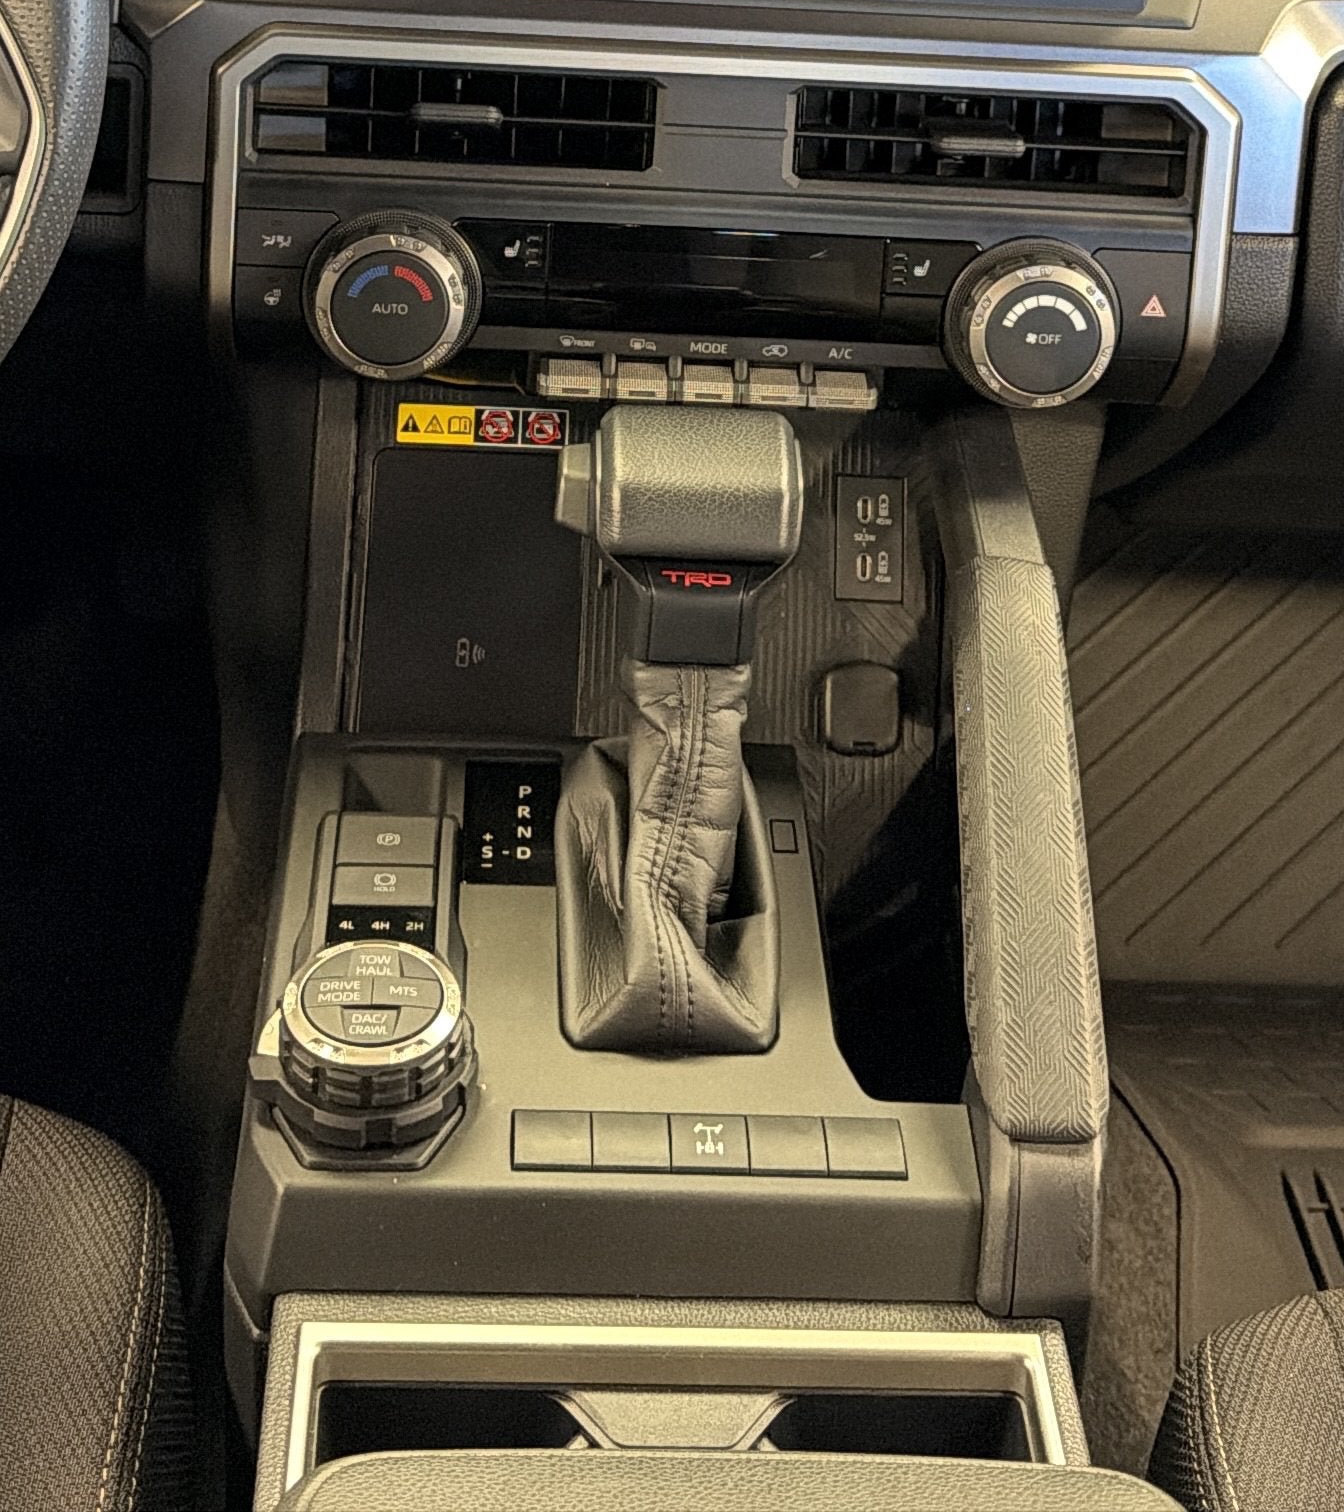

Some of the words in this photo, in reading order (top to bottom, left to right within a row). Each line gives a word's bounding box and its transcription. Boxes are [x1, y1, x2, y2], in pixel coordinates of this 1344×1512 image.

[371, 303, 409, 316] AUTO
[1037, 333, 1063, 345] OFF
[689, 341, 729, 355] MODE
[828, 347, 855, 360] A/C
[661, 570, 733, 588] TRD
[518, 786, 532, 799] P
[517, 805, 532, 819] R
[517, 826, 533, 839] N
[481, 845, 494, 859] S
[516, 846, 532, 860] D
[338, 920, 355, 931] 4L
[370, 920, 390, 931] 4H
[405, 921, 424, 931] 2H
[359, 954, 392, 965] TOW
[356, 966, 393, 977] HAUL
[319, 980, 362, 991] DRIVE
[389, 985, 419, 997] MTS
[317, 991, 361, 1003] MODE
[351, 1013, 389, 1024] DAC/
[348, 1025, 389, 1036] CRAWL
